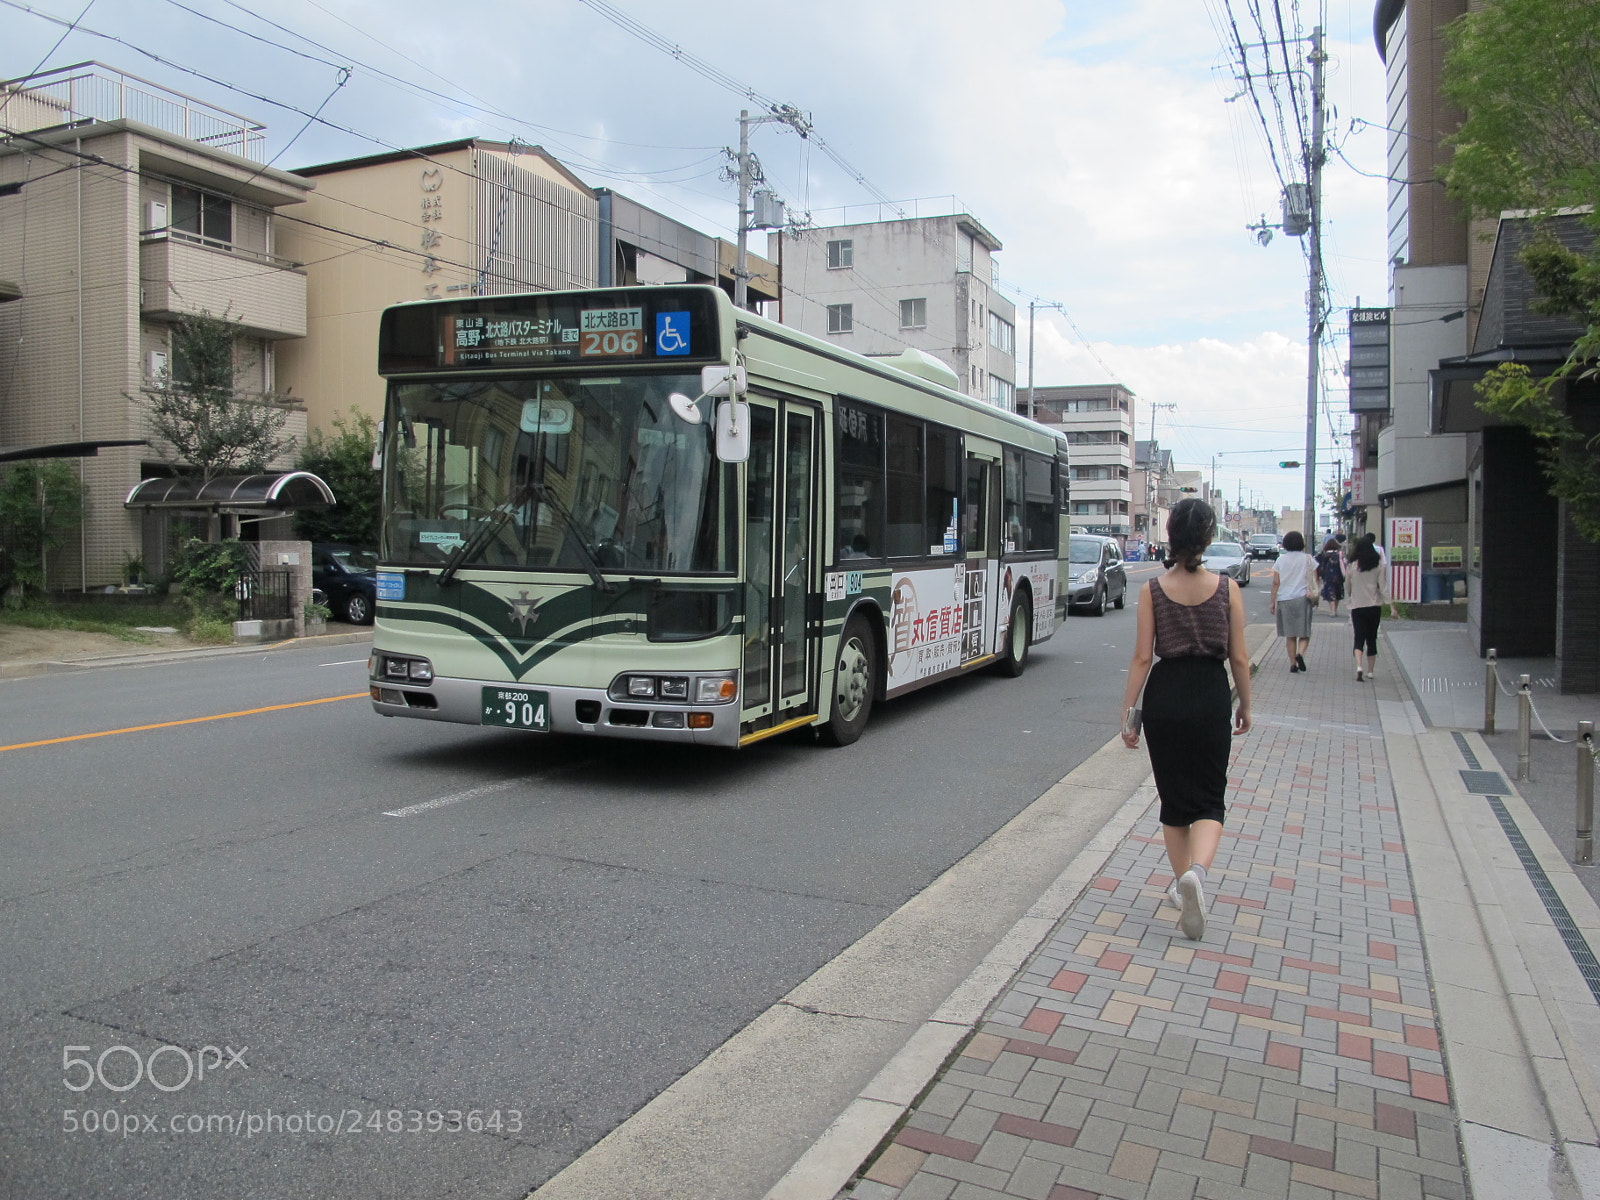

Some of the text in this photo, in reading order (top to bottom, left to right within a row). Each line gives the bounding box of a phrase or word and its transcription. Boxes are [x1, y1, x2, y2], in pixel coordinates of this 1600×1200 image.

[456, 318, 483, 328] 東山通
[585, 312, 639, 329] 北大路BT
[563, 330, 578, 341] まで
[585, 332, 638, 354] 206
[830, 575, 844, 590] 出口
[850, 573, 862, 591] 904
[912, 604, 963, 645] 丸信質店
